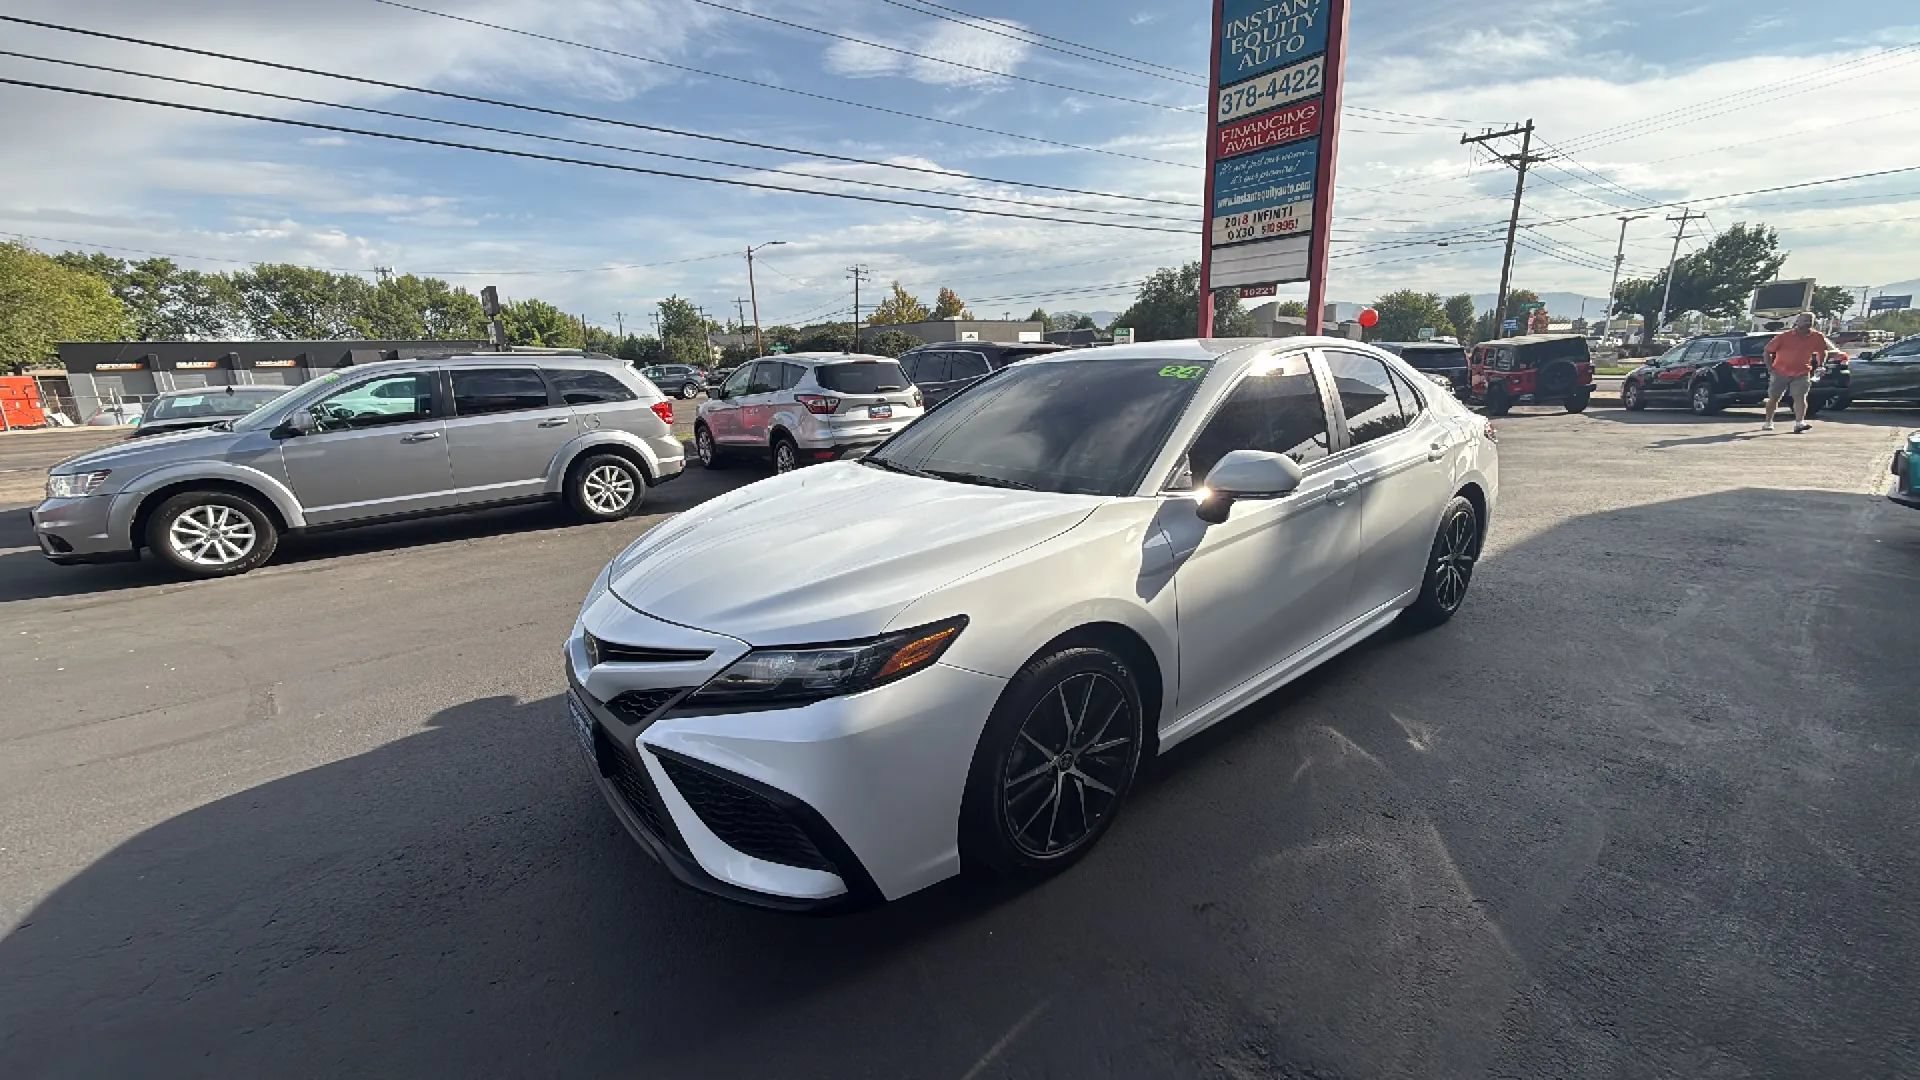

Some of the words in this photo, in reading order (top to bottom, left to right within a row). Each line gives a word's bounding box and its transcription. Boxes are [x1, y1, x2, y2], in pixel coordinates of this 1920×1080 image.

[1226, 0, 1320, 38] INSTAN
[1231, 7, 1318, 54] EQUITY
[1238, 34, 1305, 70] AUTO
[1221, 64, 1320, 115] 378-4422
[1221, 105, 1316, 143] FINANCING
[1224, 121, 1311, 153] AVAILABLE
[1225, 214, 1249, 229] 2018
